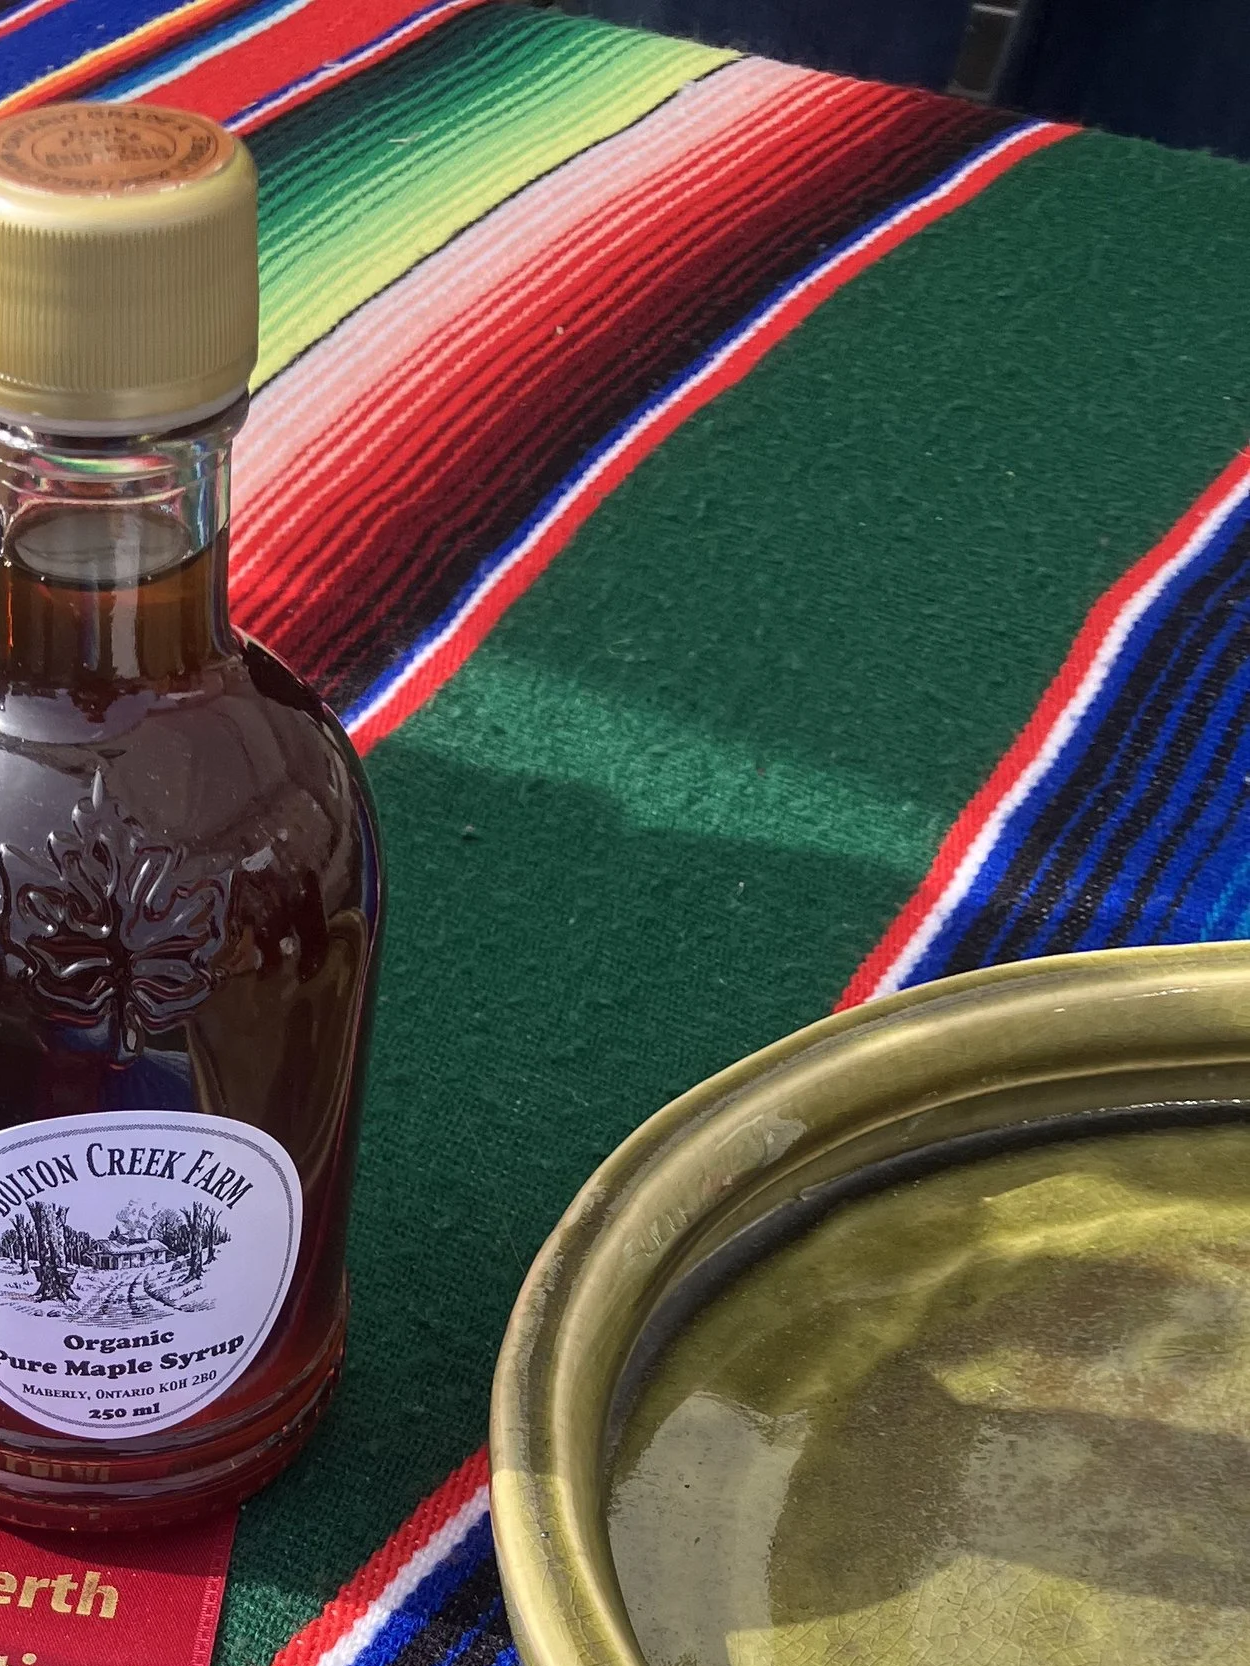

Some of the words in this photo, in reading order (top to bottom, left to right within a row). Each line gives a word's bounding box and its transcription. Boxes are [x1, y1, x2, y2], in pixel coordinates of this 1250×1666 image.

[86, 1142, 186, 1180] CREEK
[181, 1149, 253, 1210] FARM
[63, 1329, 175, 1354] Organic
[64, 1358, 153, 1380] Maple
[159, 1334, 245, 1370] Syrup
[22, 1383, 91, 1400] MABERLY,
[96, 1385, 155, 1400] ONTARIO
[88, 1408, 127, 1420] 250
[133, 1402, 161, 1416] ml
